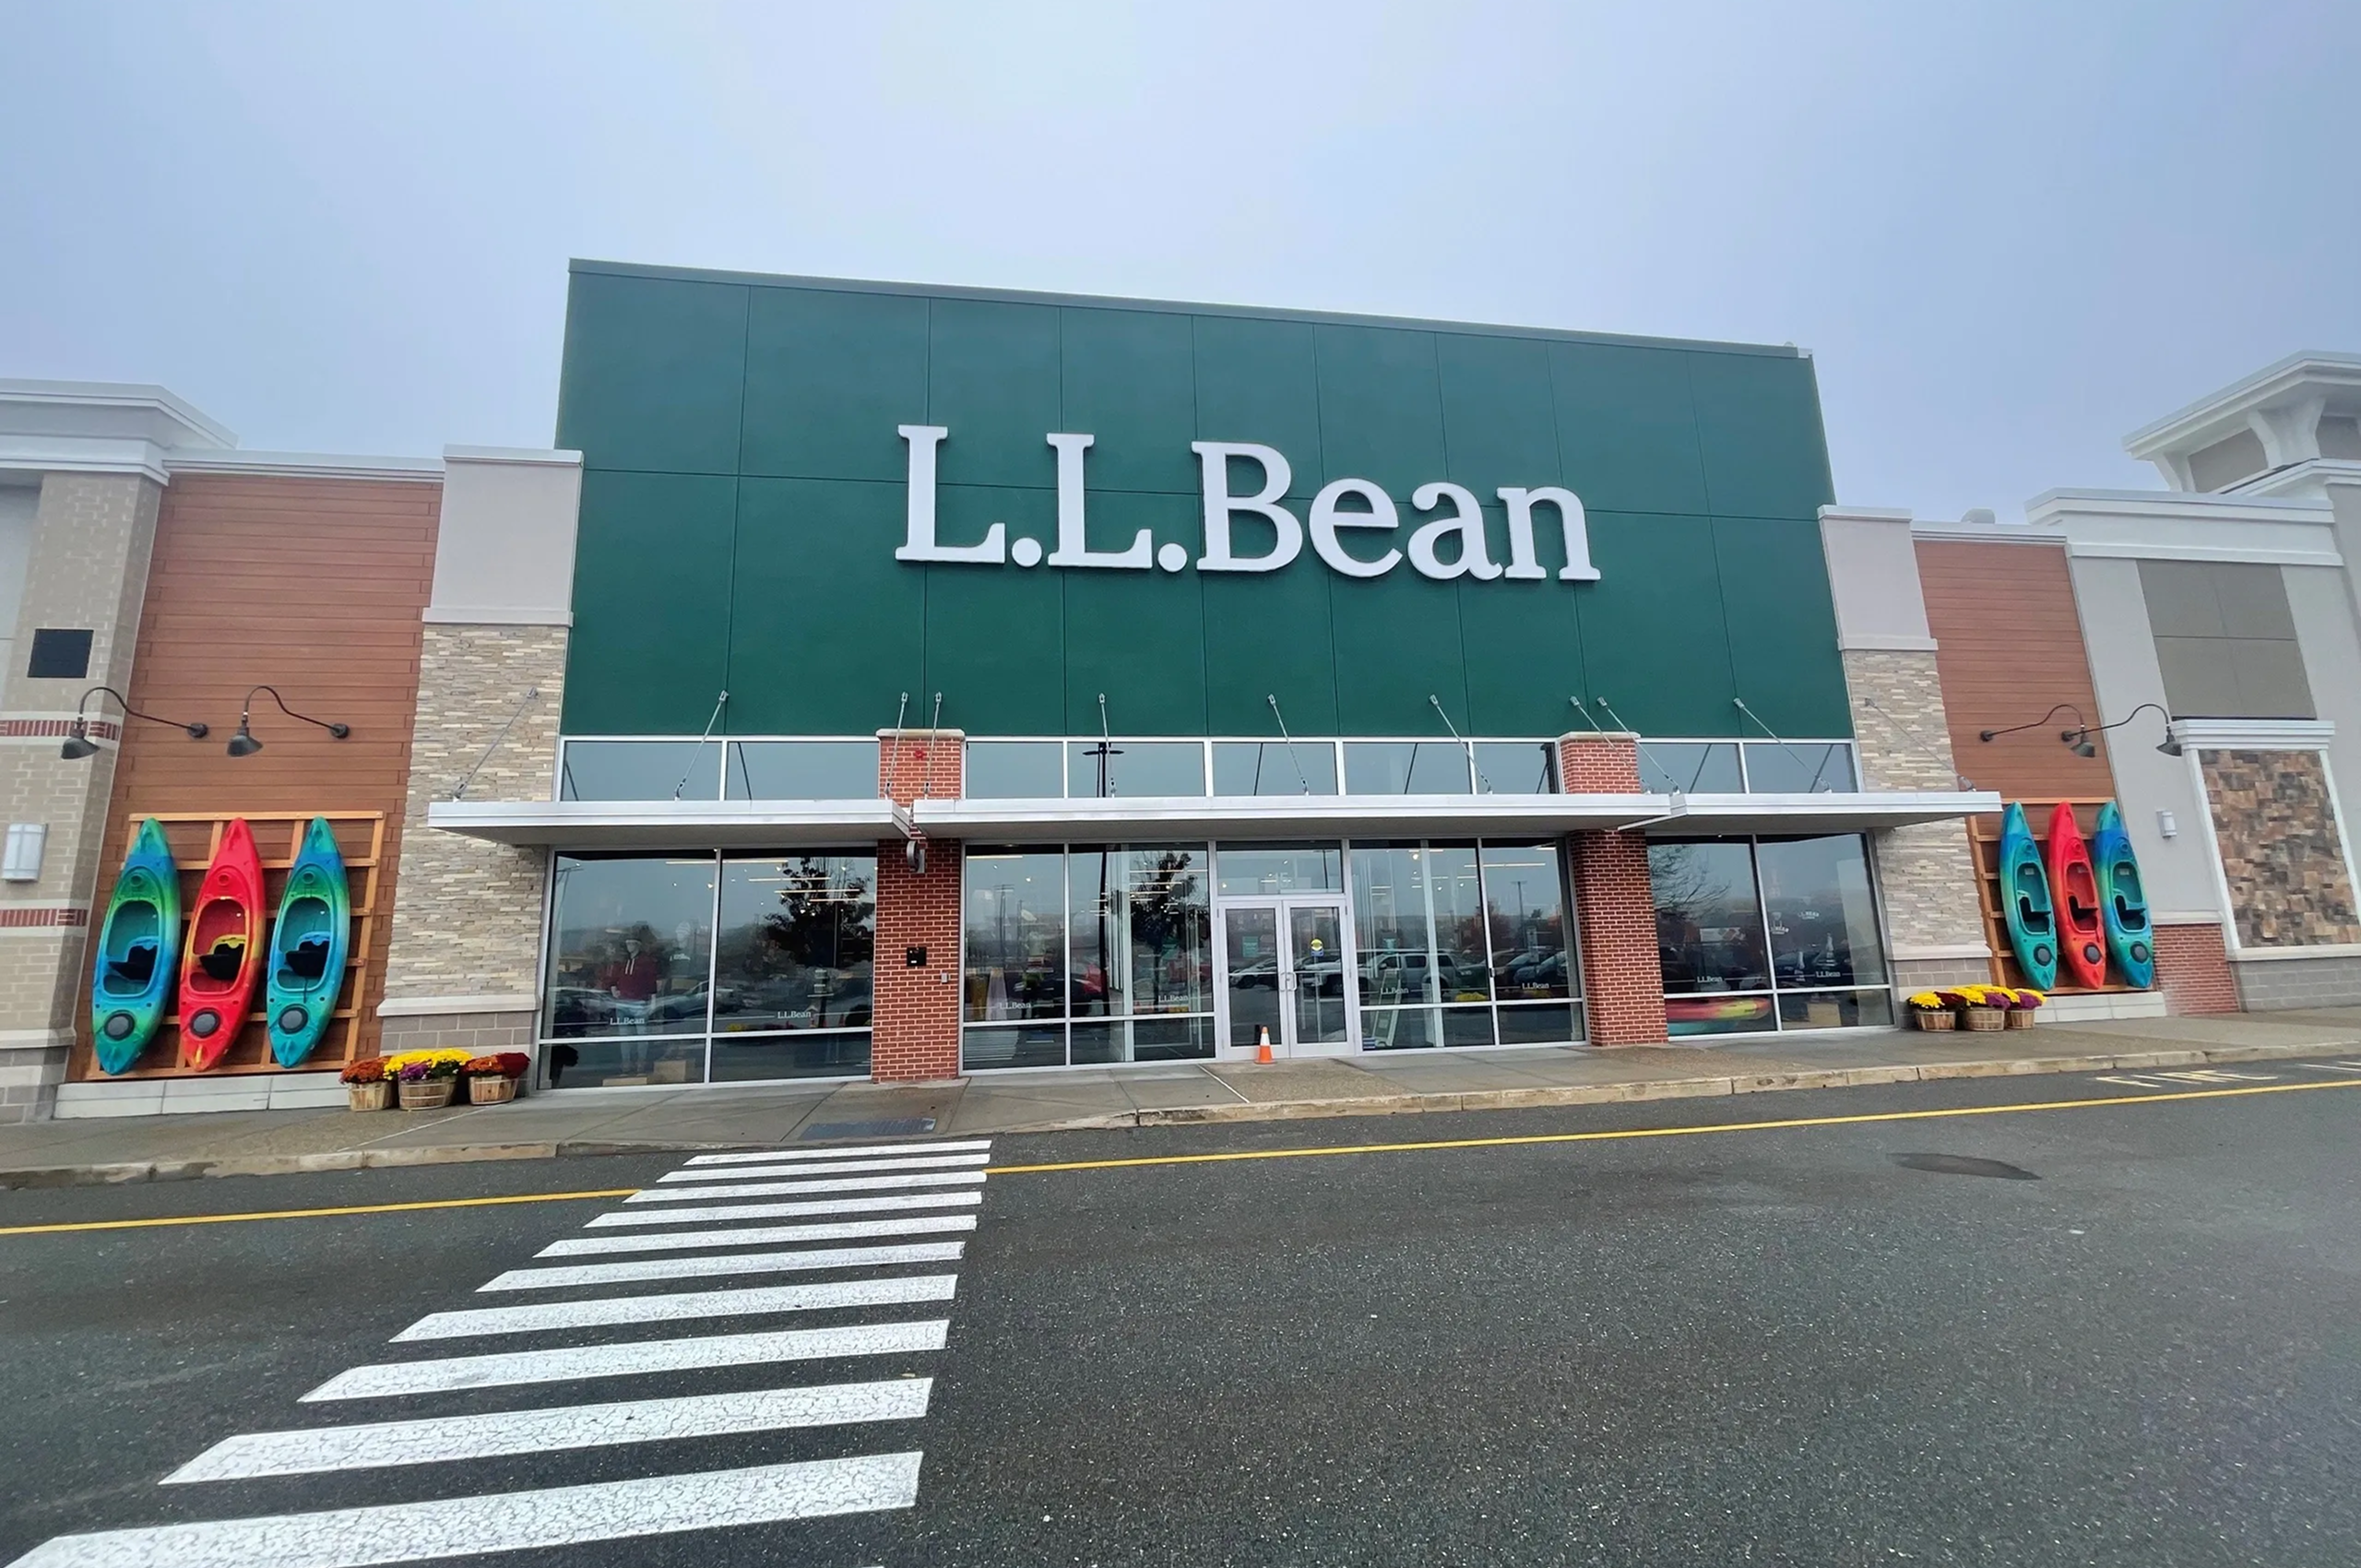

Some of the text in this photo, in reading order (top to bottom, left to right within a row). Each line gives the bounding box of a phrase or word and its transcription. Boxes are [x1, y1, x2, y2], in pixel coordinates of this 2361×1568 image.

[895, 424, 1601, 583] L.L.Bean
[777, 1010, 812, 1019] L.L.Bean
[610, 1016, 646, 1026] L.L.Bean
